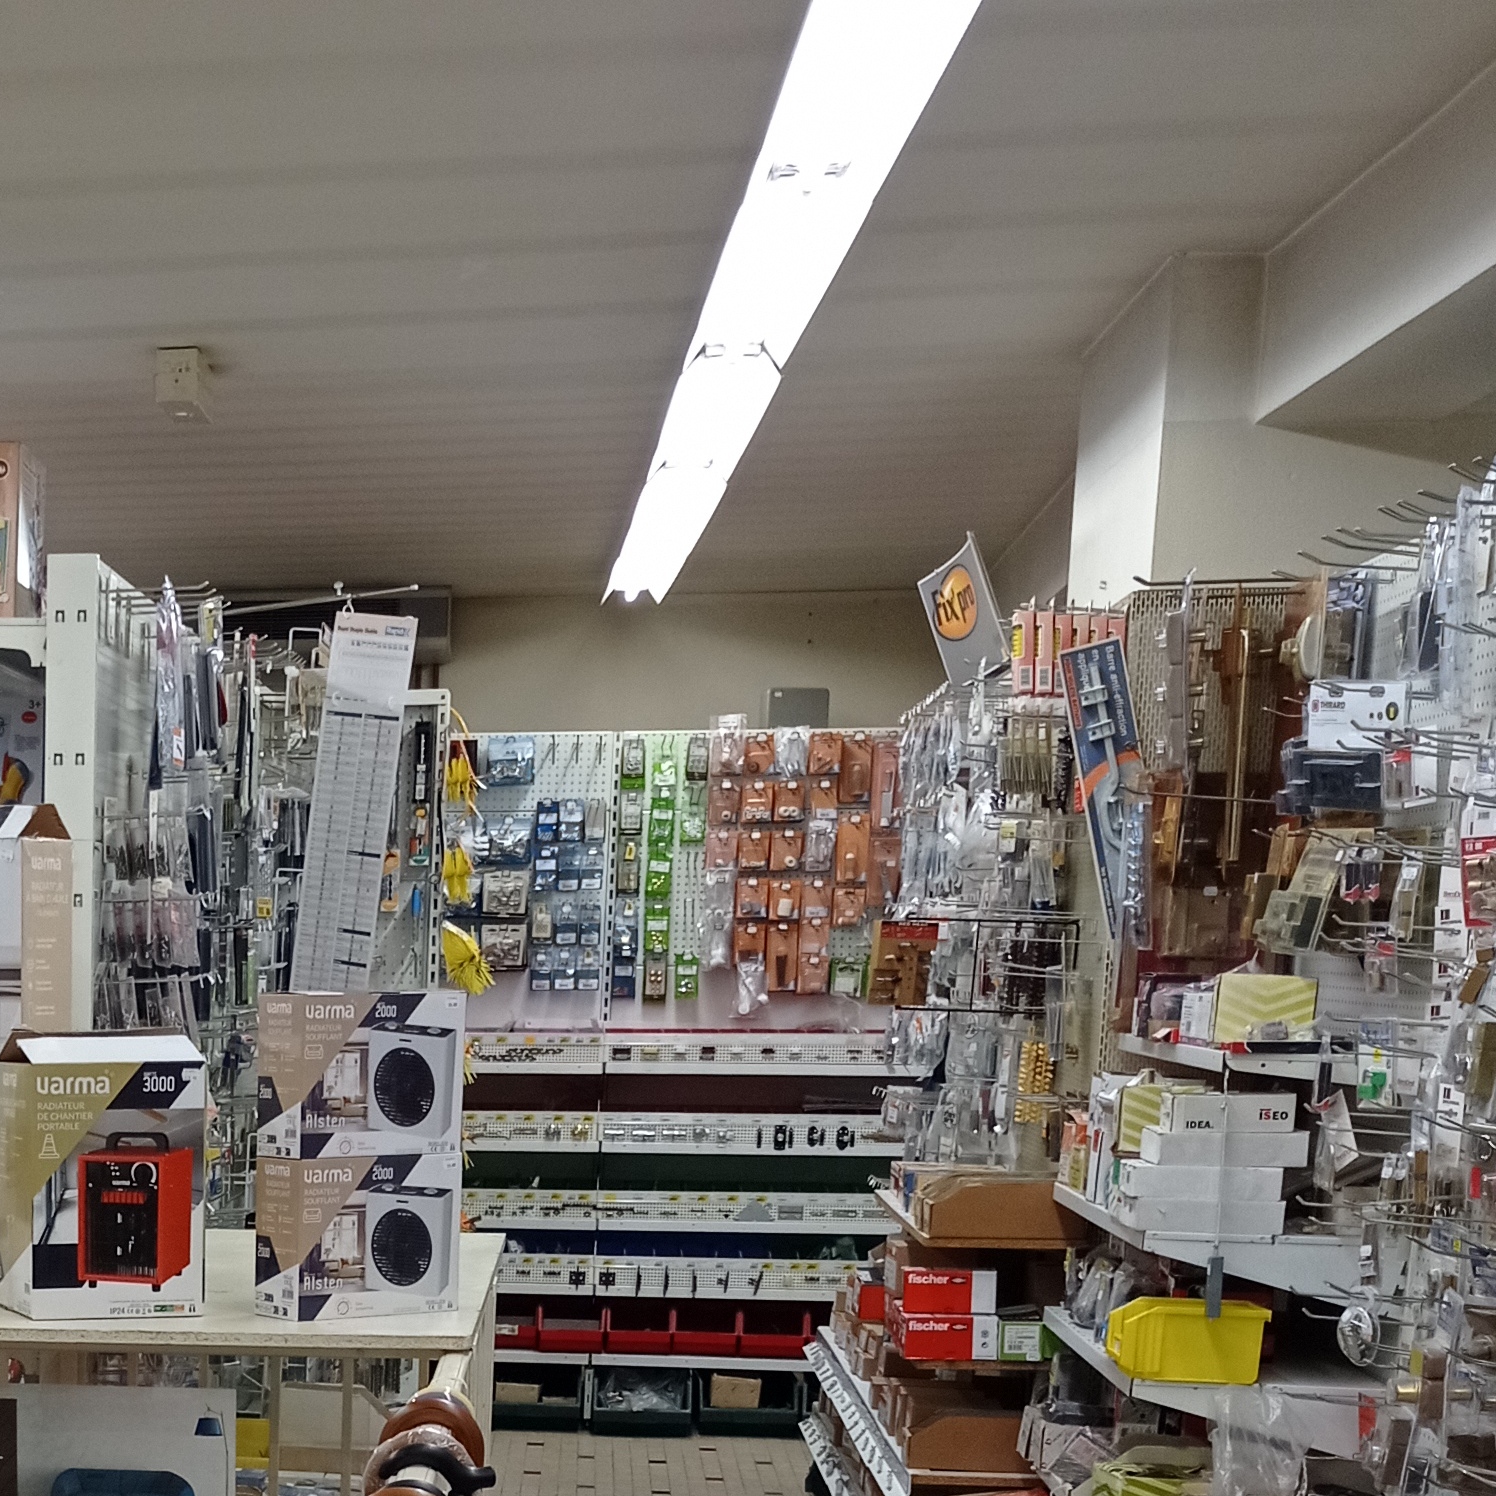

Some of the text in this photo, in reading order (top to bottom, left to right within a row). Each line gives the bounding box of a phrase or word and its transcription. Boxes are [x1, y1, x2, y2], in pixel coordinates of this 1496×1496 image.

[1092, 648, 1100, 662] en
[1105, 644, 1128, 737] Barre anti-effraction
[375, 1005, 397, 1018] 2000
[142, 1076, 175, 1093] 3000
[37, 1101, 85, 1110] RADIATEUR
[37, 1112, 94, 1121] DE CHANTIER
[305, 1113, 346, 1129] Alsten
[1258, 1108, 1289, 1121] ISEO
[37, 1121, 80, 1131] PORTABLE
[372, 1166, 394, 1180] 2000
[304, 1276, 344, 1291] Alsten
[907, 1274, 950, 1285] fischer
[908, 1320, 951, 1332] fischer
